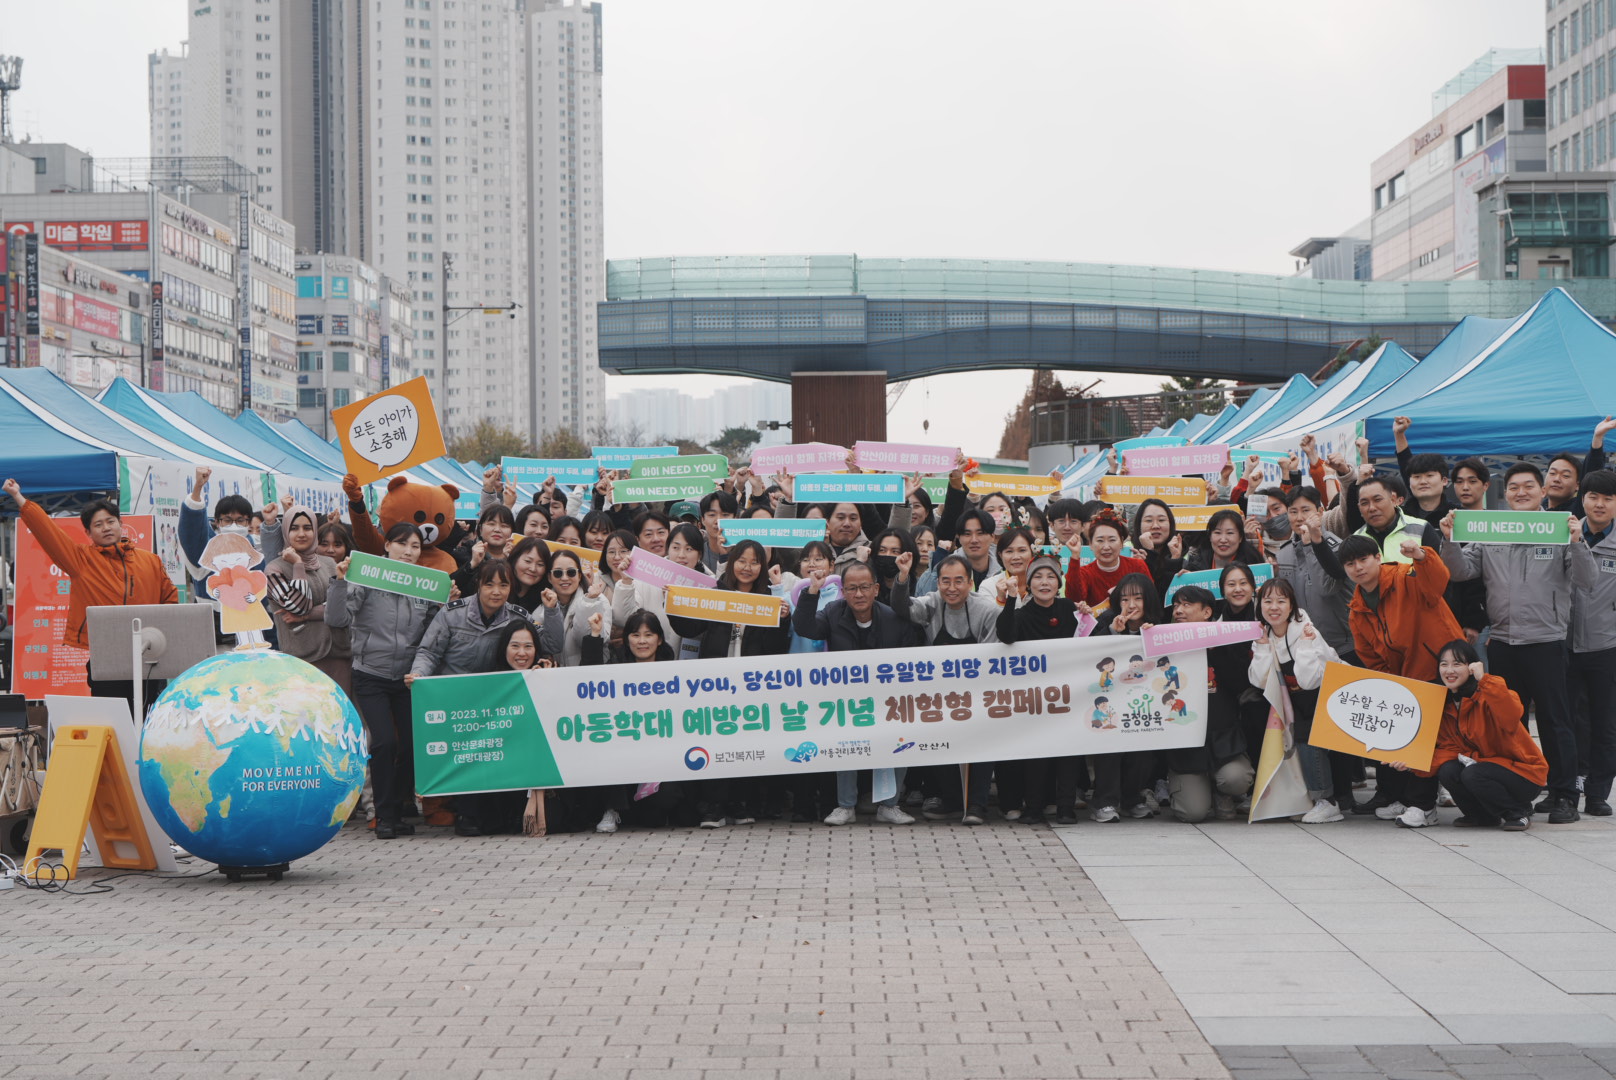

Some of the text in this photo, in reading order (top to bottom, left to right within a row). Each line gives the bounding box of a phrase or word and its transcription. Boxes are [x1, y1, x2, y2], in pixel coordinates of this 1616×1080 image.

[46, 224, 78, 242] 미술
[80, 224, 112, 241] 학원
[353, 405, 412, 439] 모든 아이가
[369, 426, 407, 453] 소중해
[757, 454, 794, 466] 안산아이
[859, 451, 897, 463] 안산아이
[921, 454, 950, 466] 지켜요
[1131, 453, 1221, 469] 안산아이 함께 지켜요
[641, 463, 717, 477] 아이 NEED YOU
[626, 486, 704, 496] 아이 NEED YOU
[930, 487, 946, 496] YO
[1106, 484, 1201, 496] 행복의 아이를 그리는 안산
[1467, 520, 1555, 535] 아이 NEED YOU
[361, 564, 439, 592] 아이 NEED YOU
[673, 594, 773, 617] 행복의 아이를 그리는 안산
[1152, 632, 1194, 647] 안산아이
[1197, 626, 1218, 638] 함께
[577, 653, 1047, 700] 아이 need you, 당신이 아이의 유일한 희망 지킴이
[450, 705, 525, 720] 2023. 11. 19.(일)
[1338, 691, 1416, 719] 실수할 수 있어
[556, 683, 1071, 743] 아동학대 예방의 날 기념 체험형 캠페인
[1121, 711, 1163, 728] 긍정양육
[452, 719, 513, 733] 12:00~15:00
[1349, 712, 1396, 734] 괜찮아
[451, 737, 504, 751] 안산문화광장
[918, 741, 950, 751] 안산시
[453, 751, 504, 764] (전망대광장)
[714, 750, 766, 763] 보건복지부
[820, 746, 871, 758] 아동권리보장원
[242, 764, 321, 778] MOVEMENT
[242, 778, 321, 792] FOR EVERYONE
